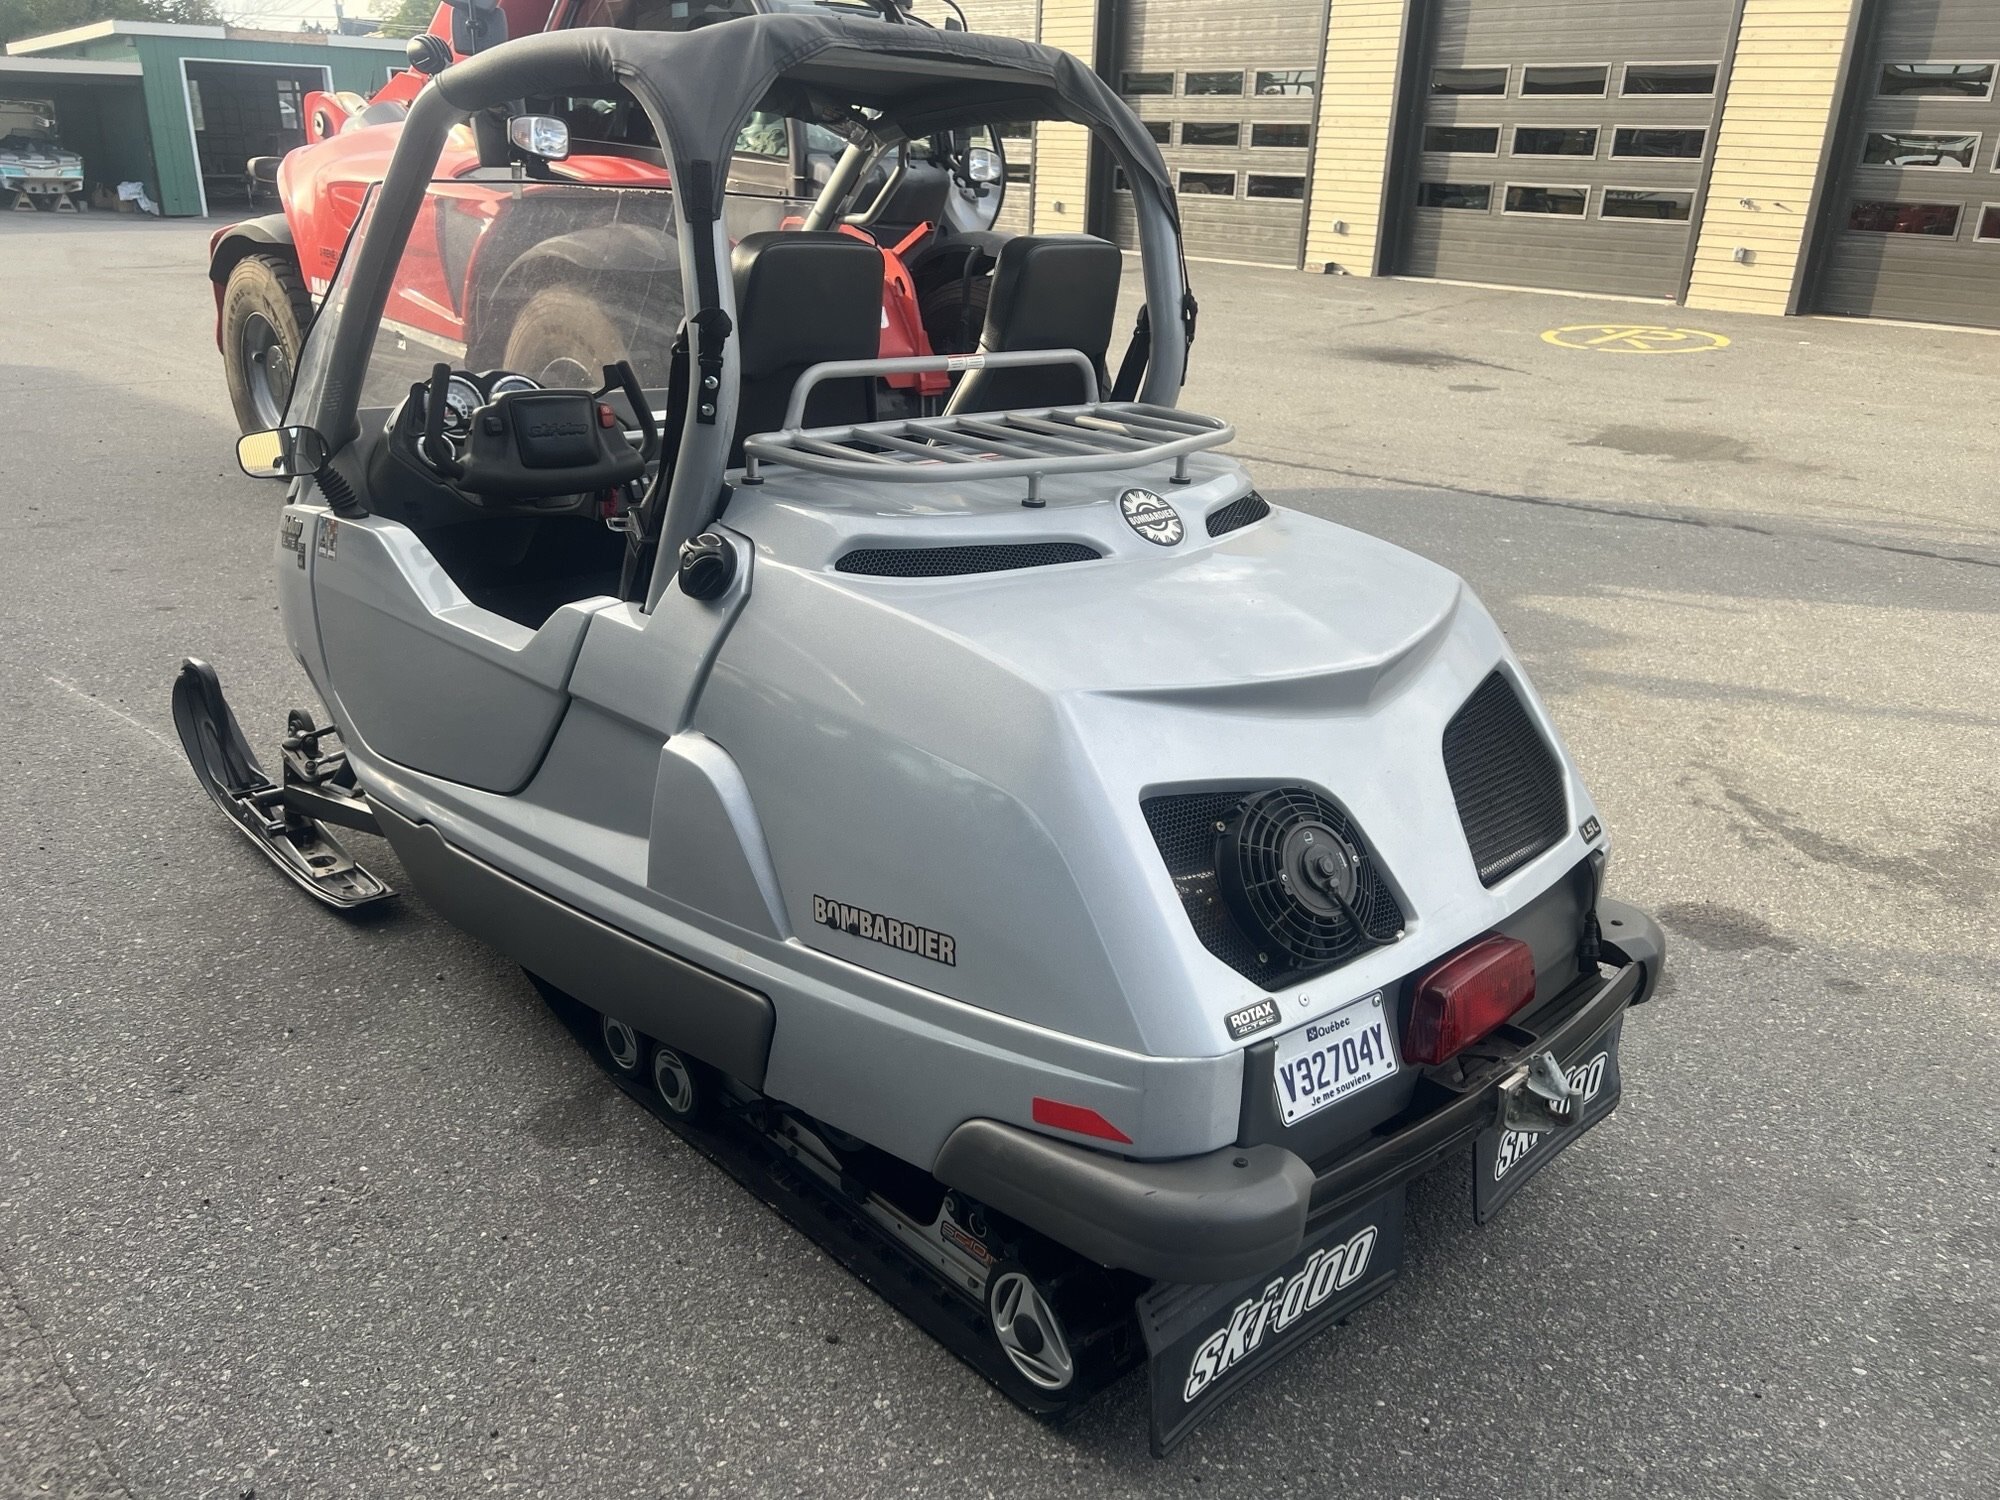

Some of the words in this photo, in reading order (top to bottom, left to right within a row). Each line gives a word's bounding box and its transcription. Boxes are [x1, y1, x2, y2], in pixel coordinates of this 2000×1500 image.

[1127, 508, 1177, 526] BOMBARDIER
[813, 894, 956, 967] BOMBARDIER
[1230, 1001, 1274, 1028] ROTAX
[1317, 1017, 1351, 1037] Québec
[1280, 1022, 1385, 1103] V32704Y
[1311, 1096, 1321, 1106] Je
[1322, 1089, 1335, 1101] me
[1336, 1072, 1372, 1095] souviens
